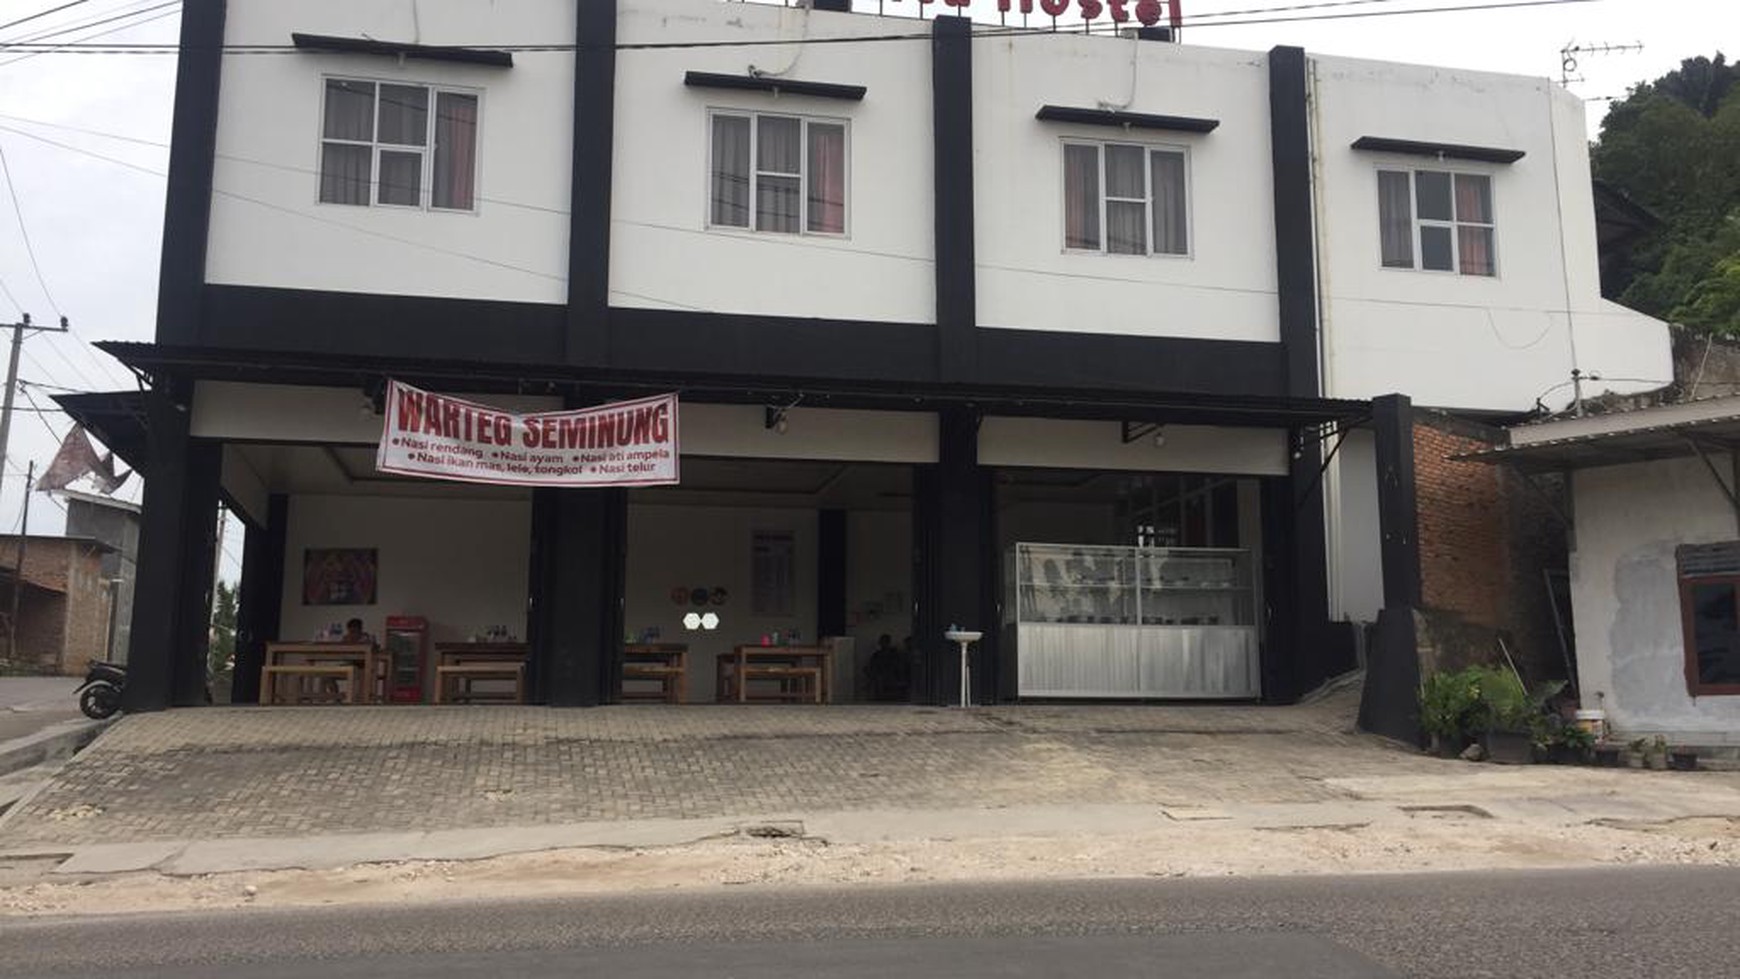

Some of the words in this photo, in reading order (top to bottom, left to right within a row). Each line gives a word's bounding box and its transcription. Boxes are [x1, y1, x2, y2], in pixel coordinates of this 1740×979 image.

[397, 386, 512, 447] WARTEG
[522, 403, 669, 449] SEMINUNG
[400, 437, 429, 450] Nasi
[430, 444, 484, 460] rendang
[500, 450, 527, 463] Nasi
[529, 453, 564, 466] ayam
[580, 452, 607, 464] Nasi
[608, 452, 626, 463] ati
[626, 449, 670, 463] ampela
[417, 452, 444, 466] Nasi
[445, 457, 473, 467] ikan
[475, 460, 505, 472] mas,
[506, 463, 532, 475] lele,
[534, 464, 583, 477] tongkol
[599, 464, 625, 474] Nasi
[628, 461, 656, 473] telur
